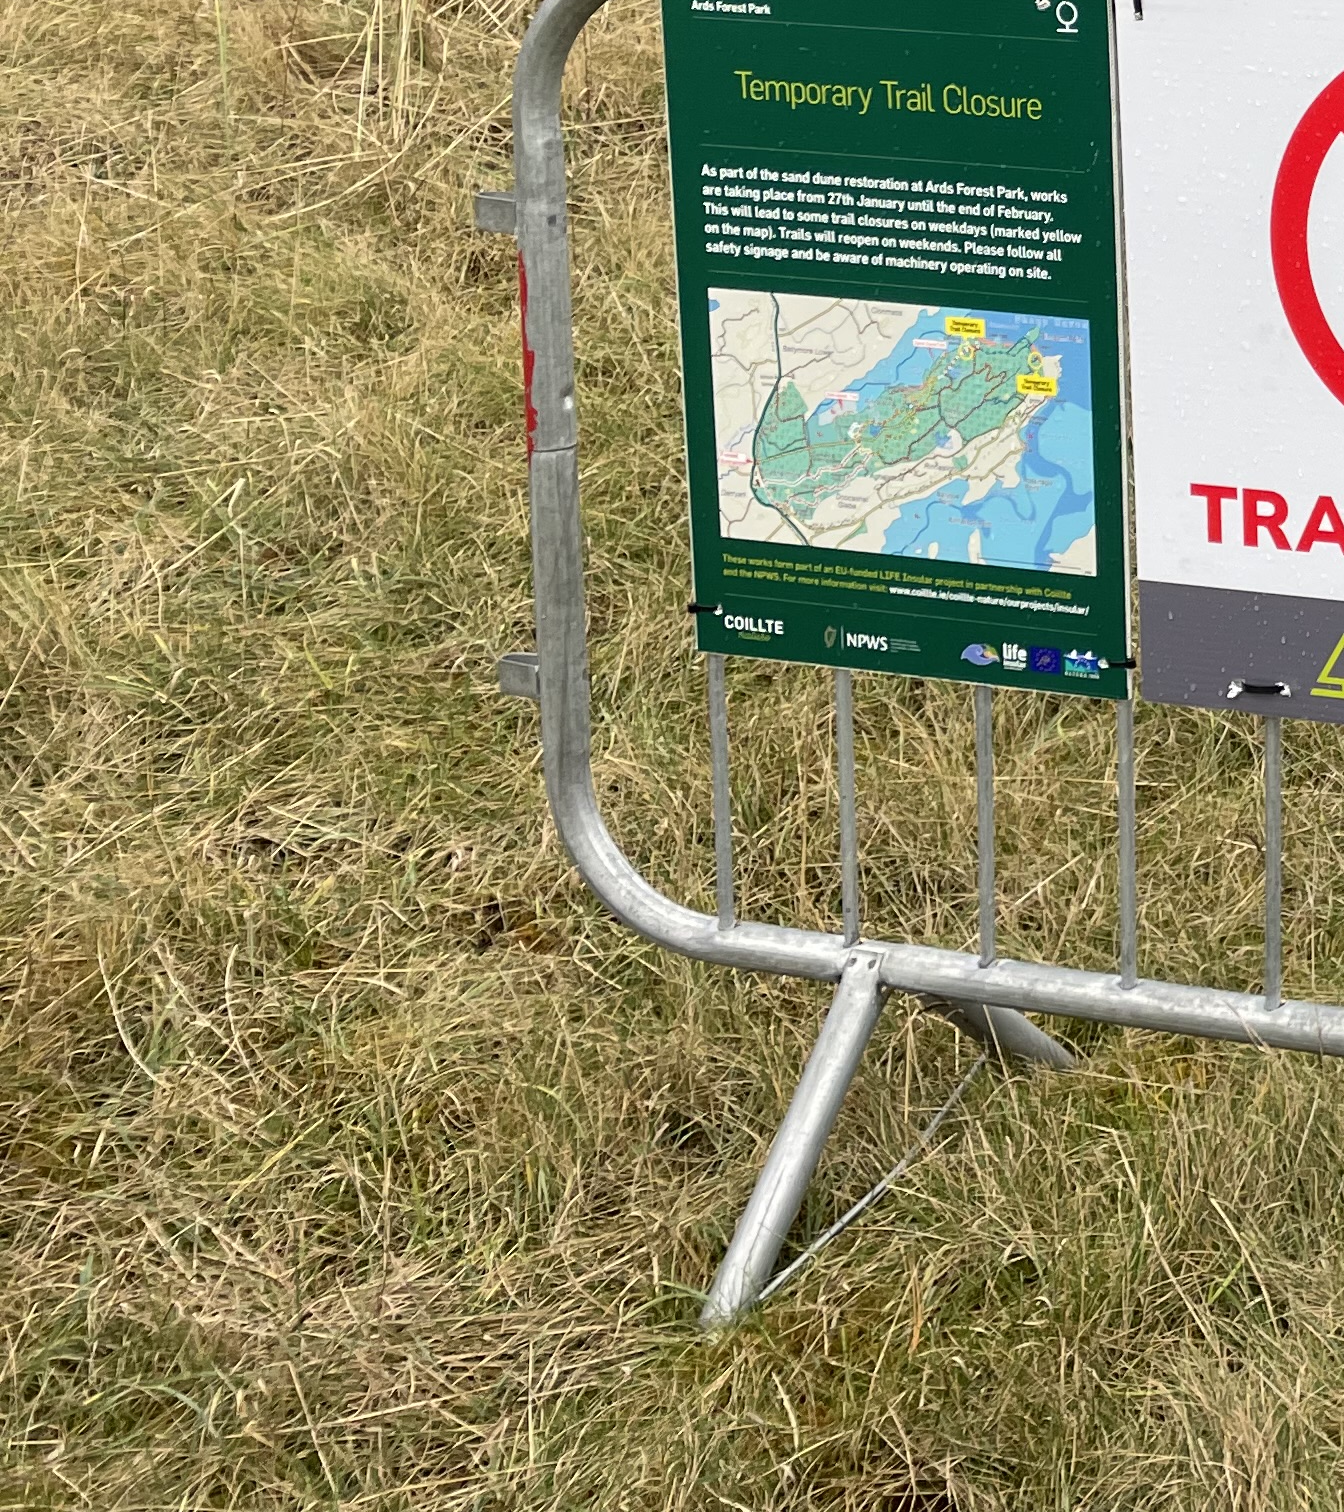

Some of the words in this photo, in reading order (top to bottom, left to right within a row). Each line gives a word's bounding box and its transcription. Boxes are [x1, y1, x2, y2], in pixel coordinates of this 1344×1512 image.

[690, 1, 715, 11] Ards
[715, 2, 747, 12] Forest
[747, 3, 771, 13] Park
[734, 70, 872, 115] Temporary
[880, 80, 936, 113] Trail
[942, 83, 1042, 120] Closure
[700, 165, 717, 177] As
[718, 167, 744, 183] part
[745, 168, 758, 180] of
[758, 169, 779, 181] the
[780, 172, 810, 183] sand
[811, 172, 842, 186] dune
[843, 176, 909, 190] restoration
[910, 180, 923, 191] at
[924, 180, 954, 193] Ards
[955, 182, 995, 196] Forest
[996, 185, 1028, 204] Park,
[1029, 189, 1068, 201] works
[701, 187, 722, 196] are
[723, 185, 761, 204] taking
[762, 188, 795, 204] place
[796, 190, 825, 203] from
[826, 192, 854, 205] 27th
[855, 194, 905, 214] January
[906, 199, 934, 211] until
[935, 200, 956, 213] the
[957, 203, 981, 214] end
[982, 204, 995, 215] of
[996, 204, 1054, 225] February.
[724, 616, 784, 635] COILLTE
[846, 633, 888, 651] NPWS
[1002, 642, 1027, 660] life
